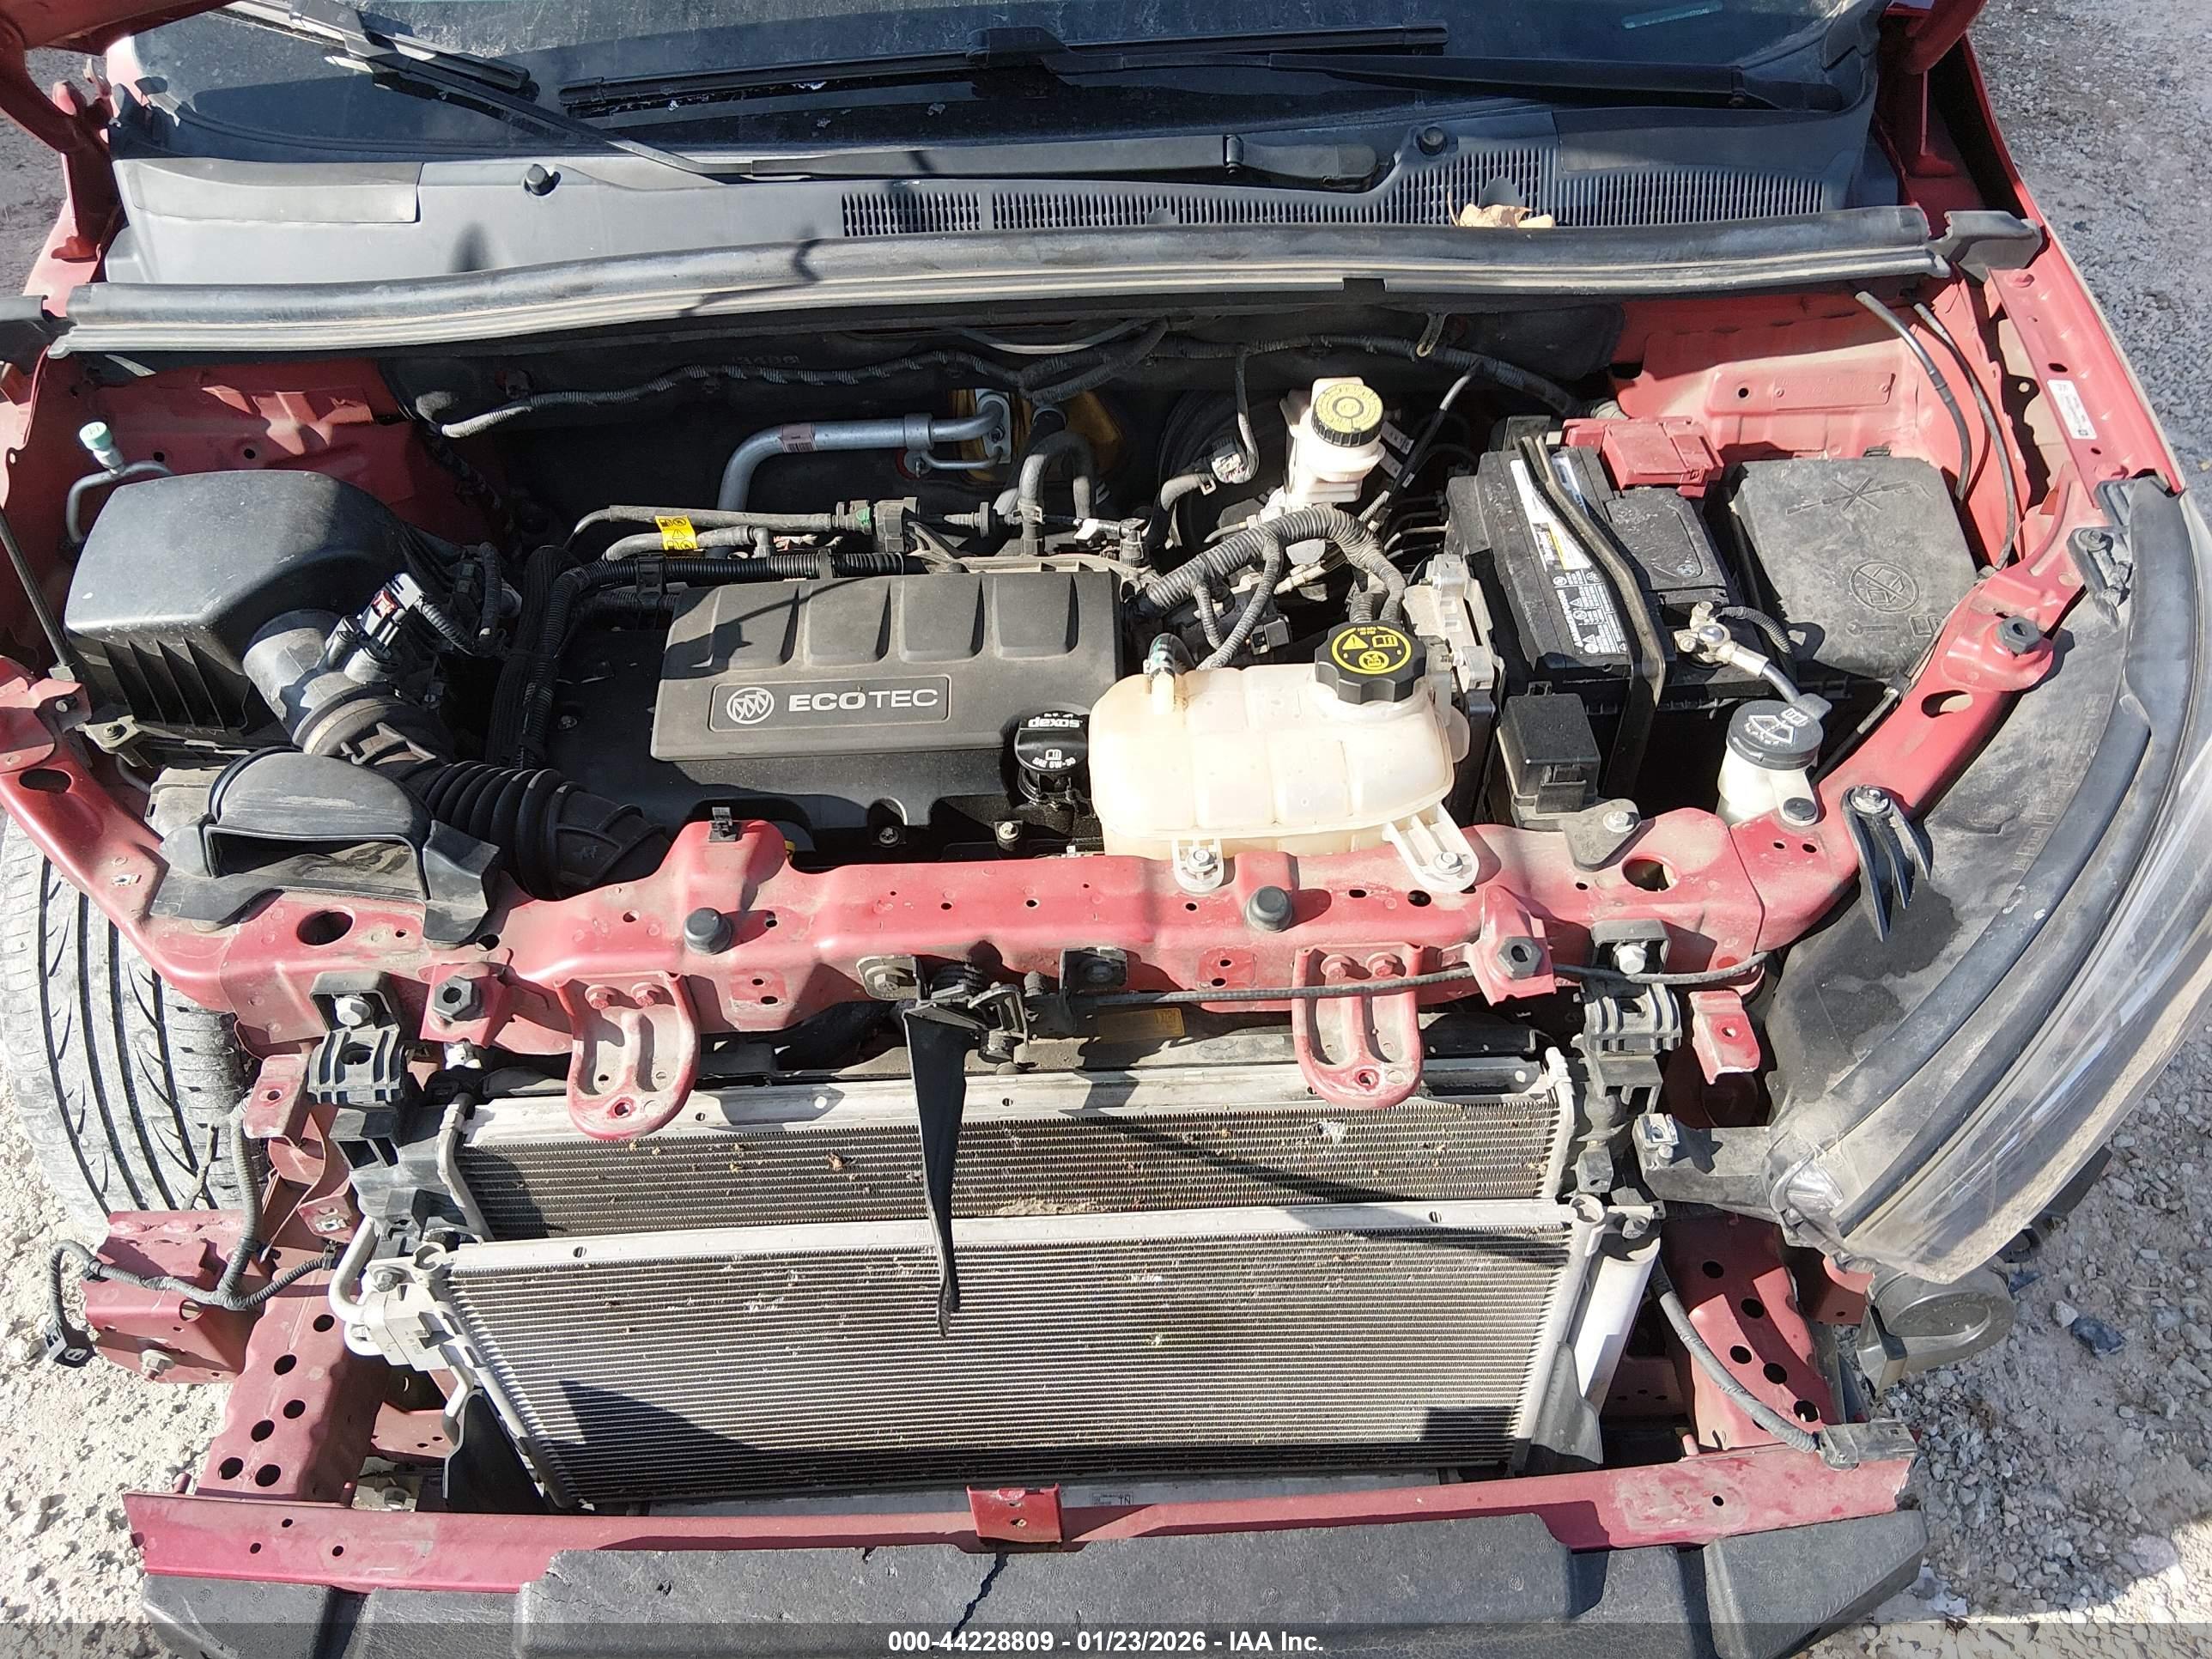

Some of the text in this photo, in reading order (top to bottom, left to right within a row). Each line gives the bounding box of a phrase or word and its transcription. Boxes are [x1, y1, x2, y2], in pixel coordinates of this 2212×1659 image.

[788, 688, 939, 712] ECOTEC
[1028, 716, 1081, 728] dexos
[1032, 757, 1048, 768] SAE
